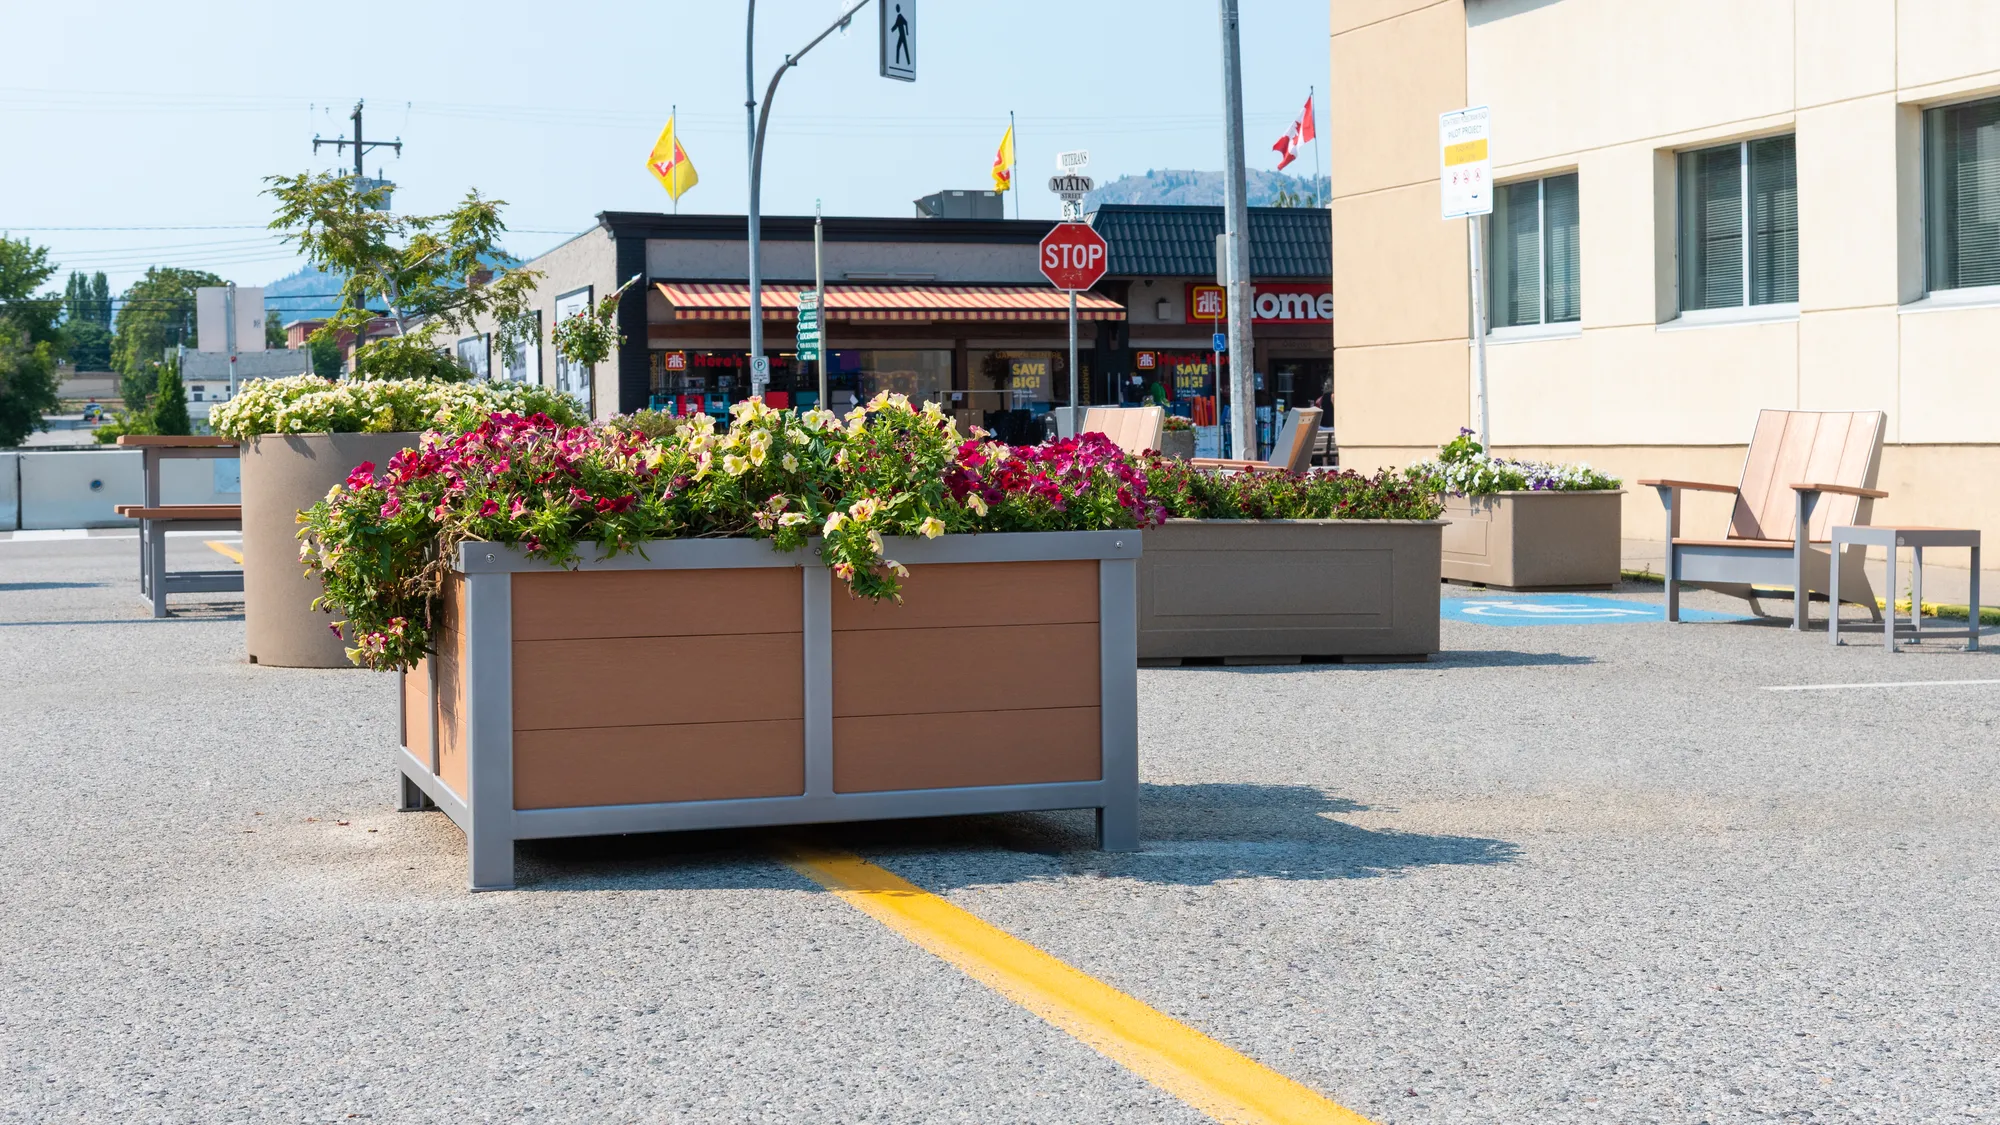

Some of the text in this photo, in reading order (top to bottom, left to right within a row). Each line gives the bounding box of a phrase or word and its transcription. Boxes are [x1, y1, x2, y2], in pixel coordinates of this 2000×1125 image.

[1062, 152, 1087, 167] VETERANS
[1052, 178, 1090, 191] MAIN
[1045, 244, 1103, 269] STOP
[757, 361, 763, 369] P
[1012, 363, 1046, 375] SAVE
[1176, 363, 1209, 375] SAVE
[1012, 376, 1041, 388] BIG!
